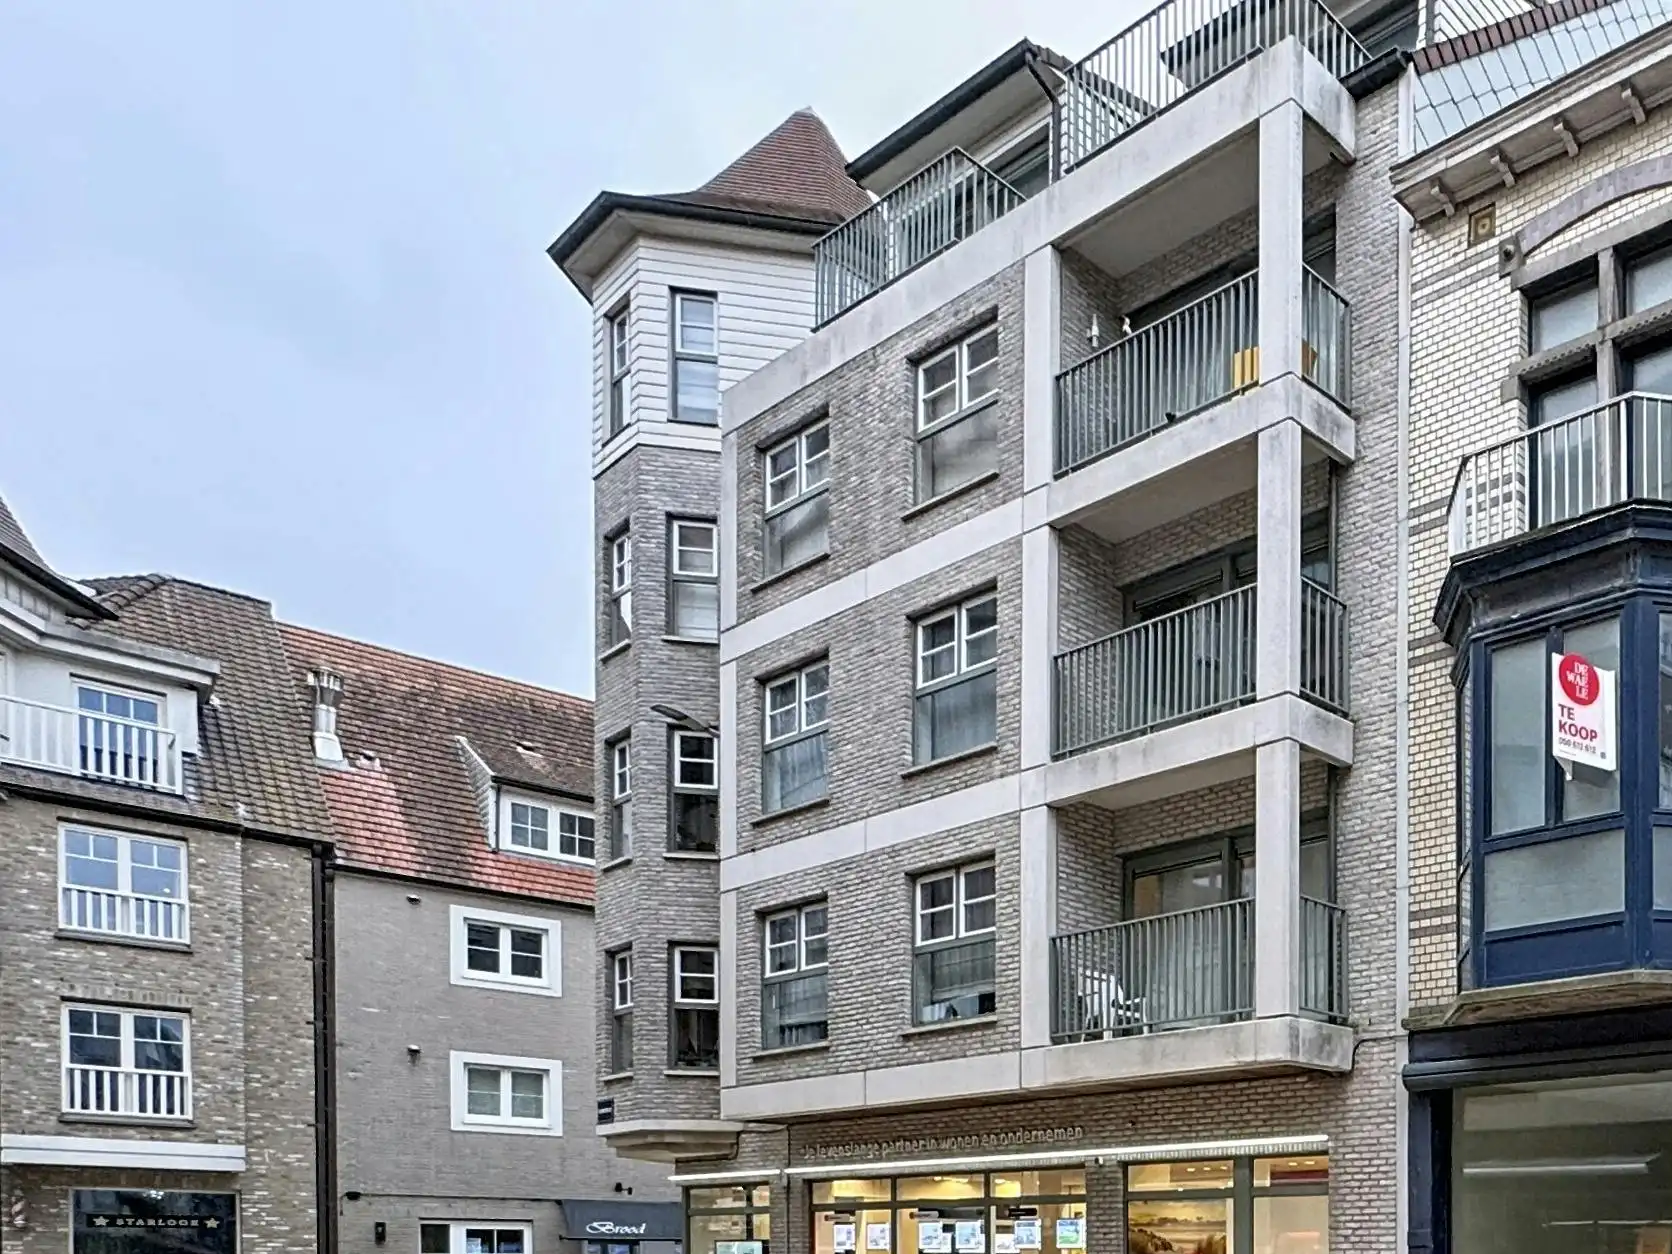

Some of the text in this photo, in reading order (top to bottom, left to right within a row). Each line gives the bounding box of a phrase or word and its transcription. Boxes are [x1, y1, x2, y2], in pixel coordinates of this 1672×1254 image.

[1558, 703, 1576, 721] TE
[1558, 719, 1598, 742] KOOP
[882, 1138, 925, 1158] partner
[926, 1137, 938, 1150] in
[940, 1134, 979, 1149] wonen
[981, 1132, 997, 1146] en
[999, 1127, 1084, 1145] ondernemen
[586, 1221, 647, 1234] Brood
